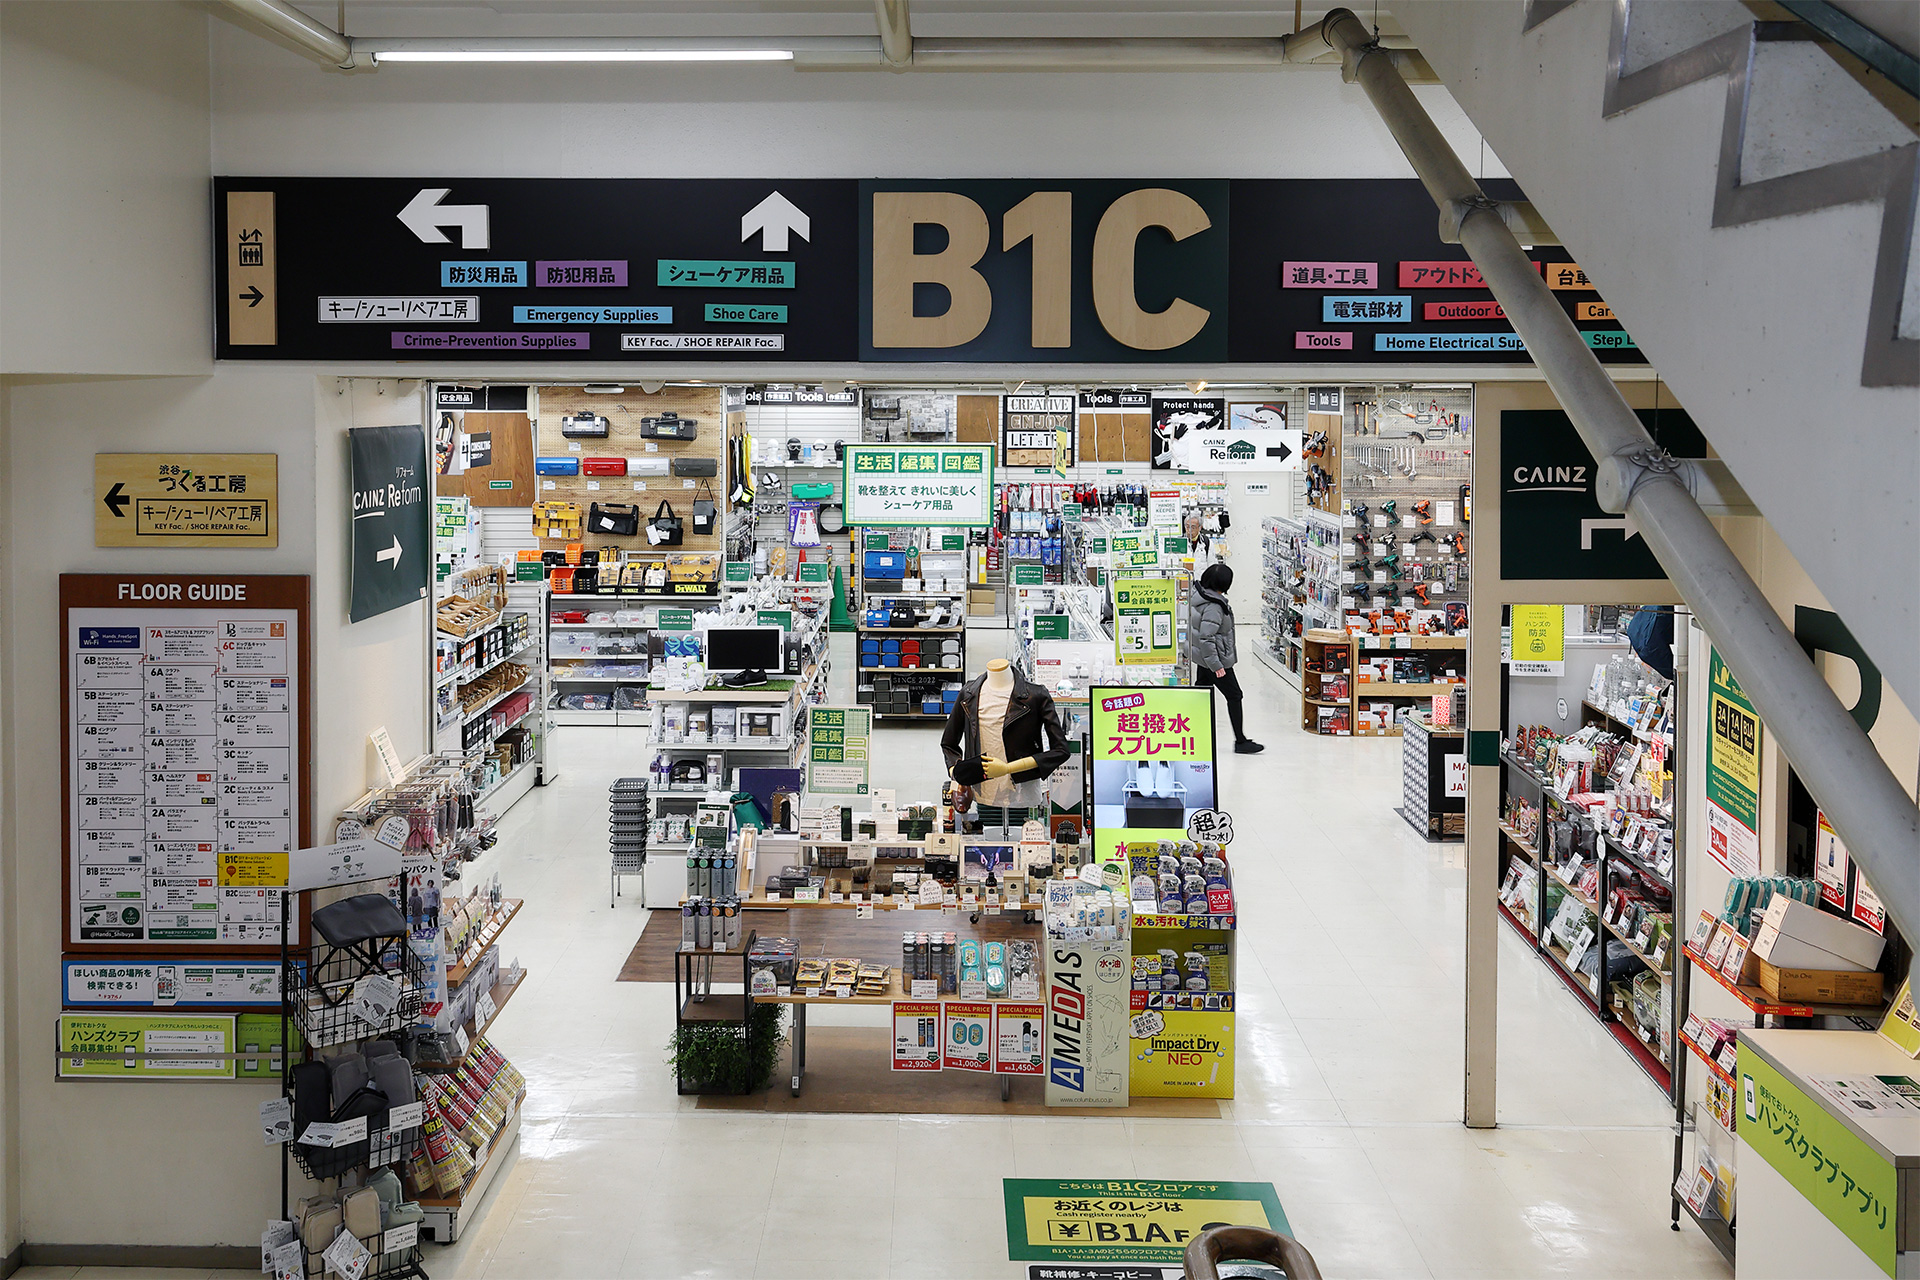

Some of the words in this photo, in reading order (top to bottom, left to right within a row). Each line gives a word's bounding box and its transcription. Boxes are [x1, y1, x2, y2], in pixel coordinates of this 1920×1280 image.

[449, 267, 518, 283] 防災用品
[669, 265, 785, 284] シューケア用品
[873, 188, 1212, 350] B1C
[547, 267, 616, 284] 防犯用品
[1292, 268, 1369, 284] 道具・工具
[328, 300, 468, 318] キー/シューリペア工房
[713, 308, 745, 320] Shoe
[749, 309, 779, 320] Care
[1333, 302, 1403, 318] 電気部材
[1438, 305, 1491, 318] Outdoor
[527, 310, 599, 323] Emergency
[603, 310, 659, 323] Supplies
[404, 335, 517, 347] Crime-Prevention
[521, 336, 577, 349] Supplies
[628, 338, 646, 347] KEY
[651, 338, 673, 347] Fac.
[684, 338, 713, 347] SHOE
[716, 338, 751, 347] REPAIR
[754, 338, 777, 348] Fac.
[1306, 335, 1342, 347] Tools
[1386, 337, 1425, 348] Home
[1429, 336, 1494, 348] Electrical
[1593, 334, 1622, 347] Step
[795, 392, 823, 401] Tools
[1085, 394, 1113, 403] Tools
[1012, 399, 1068, 410] CREATIVE
[1011, 415, 1068, 428] ENJOY
[1211, 448, 1255, 459] Reform
[857, 455, 893, 471] 生活
[901, 455, 937, 471] 編集
[944, 455, 981, 471] 図鑑
[159, 464, 180, 475] 渋谷
[1513, 466, 1587, 484] CAINZ
[158, 470, 247, 494] つくる工房
[354, 490, 385, 511] CAINZ
[387, 483, 421, 508] Reform
[858, 485, 907, 497] 靴を整えて
[910, 485, 978, 497] きれいに美しく
[883, 500, 953, 511] シューケア用品
[143, 504, 263, 522] キー/シューリペア工房
[190, 523, 210, 531] SHOE
[1113, 539, 1137, 550] 生活
[118, 584, 182, 601] FLOOR
[188, 584, 247, 601] GUIDE
[675, 585, 707, 593] DEWALT
[1132, 597, 1172, 605] 会員募集中!
[151, 630, 163, 638] 7A
[1529, 629, 1546, 637] 防災
[223, 642, 235, 650] 6C
[84, 657, 96, 665] 6B
[151, 668, 163, 676] 6A
[224, 680, 235, 688] 5C
[1104, 695, 1142, 710] 今話題の
[224, 715, 235, 723] 4C
[814, 712, 843, 724] 生活
[1718, 705, 1727, 724] 3A
[1117, 713, 1190, 733] 超撥水
[1731, 713, 1740, 731] 1A
[85, 727, 97, 735] 4B
[814, 730, 843, 743] 編集
[1108, 735, 1195, 755] スプレー!!
[813, 748, 842, 760] 図鑑
[152, 774, 164, 782] 3A
[152, 809, 165, 817] 2A
[1193, 812, 1216, 834] 超
[1203, 833, 1228, 842] はっ水!
[153, 844, 165, 852] 1A
[86, 868, 99, 876] B1B
[153, 879, 167, 887] B1A
[1050, 893, 1072, 902] 防水!
[1135, 916, 1187, 927] 水も汚れも
[1100, 959, 1121, 968] 水・油
[74, 969, 151, 977] ほしい商品の場所を
[87, 981, 138, 990] 検索できる!
[1053, 950, 1083, 1089] AMEDAS
[71, 1031, 141, 1042] ハンズクラブ
[71, 1044, 118, 1052] 会員募集中!
[1151, 1038, 1195, 1053] Impact
[1197, 1038, 1220, 1053] Dry
[1167, 1053, 1203, 1066] NEO
[1759, 1085, 1800, 1126] 便利でおトクな
[1759, 1103, 1887, 1230] ハンズクラブアプリ
[1059, 1182, 1219, 1193] こちらはB1Cフロアです
[1054, 1200, 1184, 1212] お近くのレジは
[1095, 1222, 1172, 1243] B1A
[1174, 1230, 1190, 1243] F
